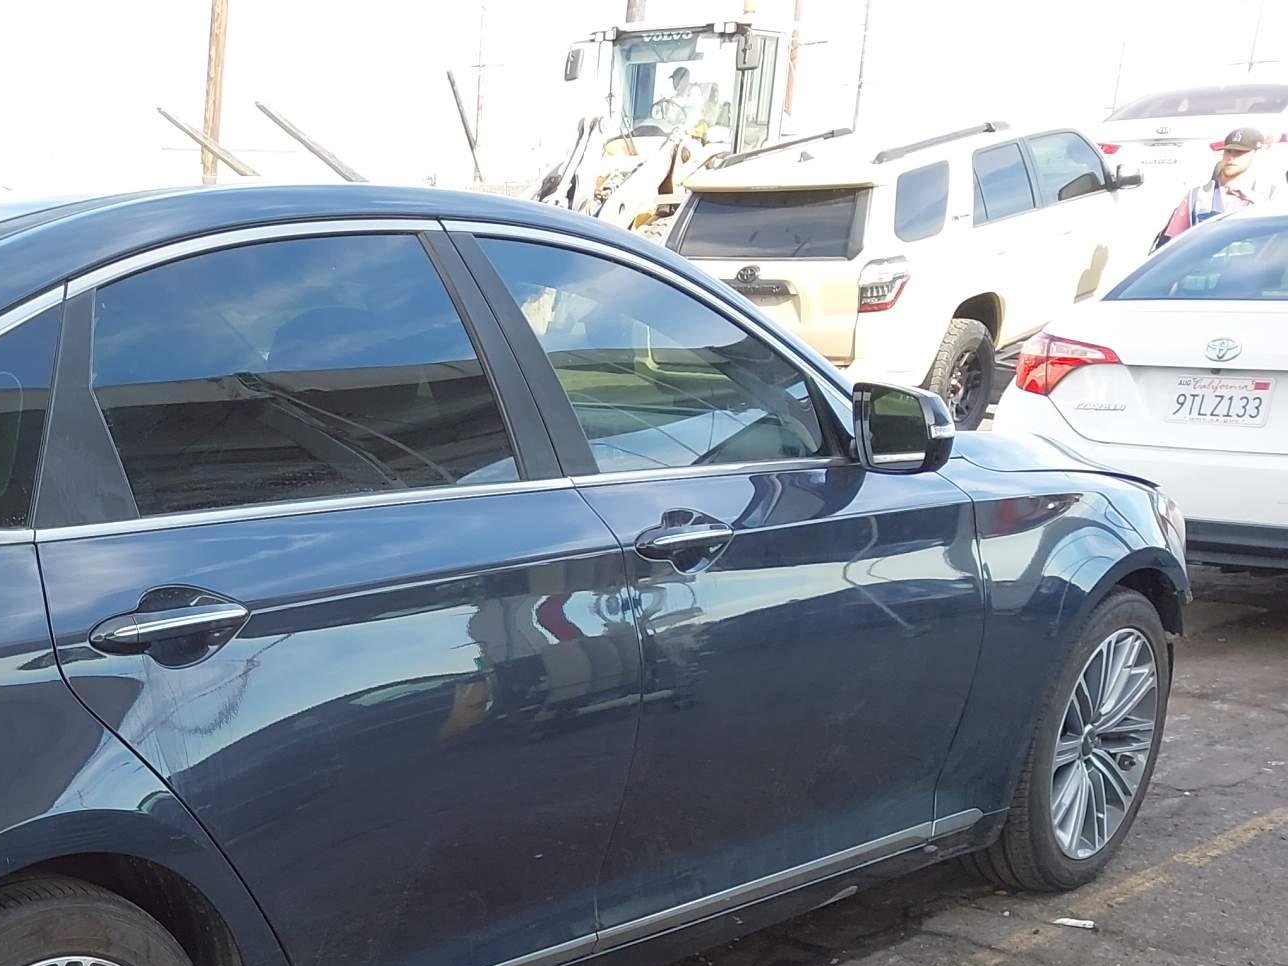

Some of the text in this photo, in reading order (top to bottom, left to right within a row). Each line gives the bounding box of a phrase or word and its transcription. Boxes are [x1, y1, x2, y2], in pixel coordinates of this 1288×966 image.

[642, 31, 692, 42] VOLVO
[1192, 378, 1253, 393] California
[1172, 393, 1263, 419] 9TLZ133
